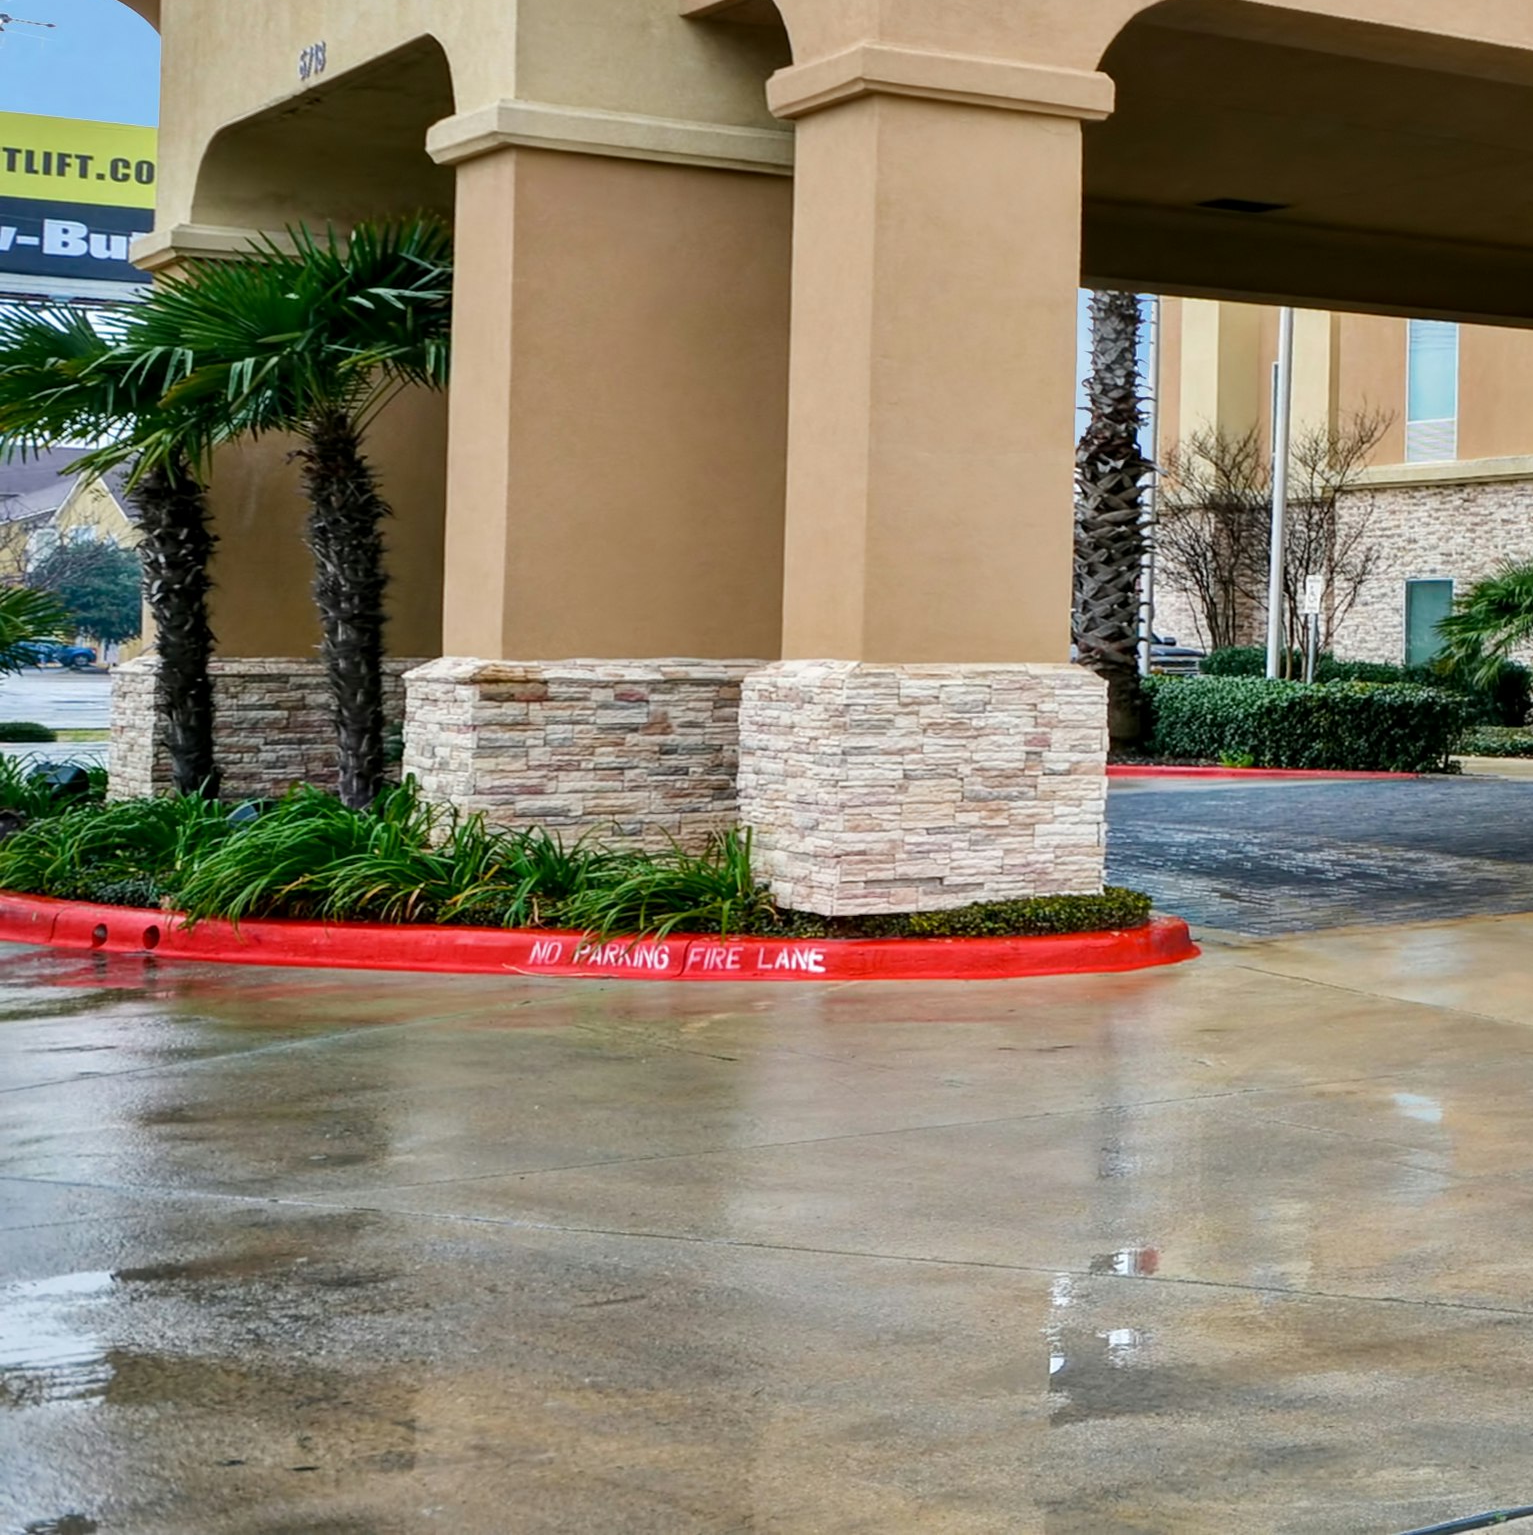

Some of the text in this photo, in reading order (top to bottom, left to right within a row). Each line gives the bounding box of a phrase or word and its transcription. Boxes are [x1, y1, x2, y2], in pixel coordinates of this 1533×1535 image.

[528, 941, 827, 973] NO PARKING FIRE LANE
